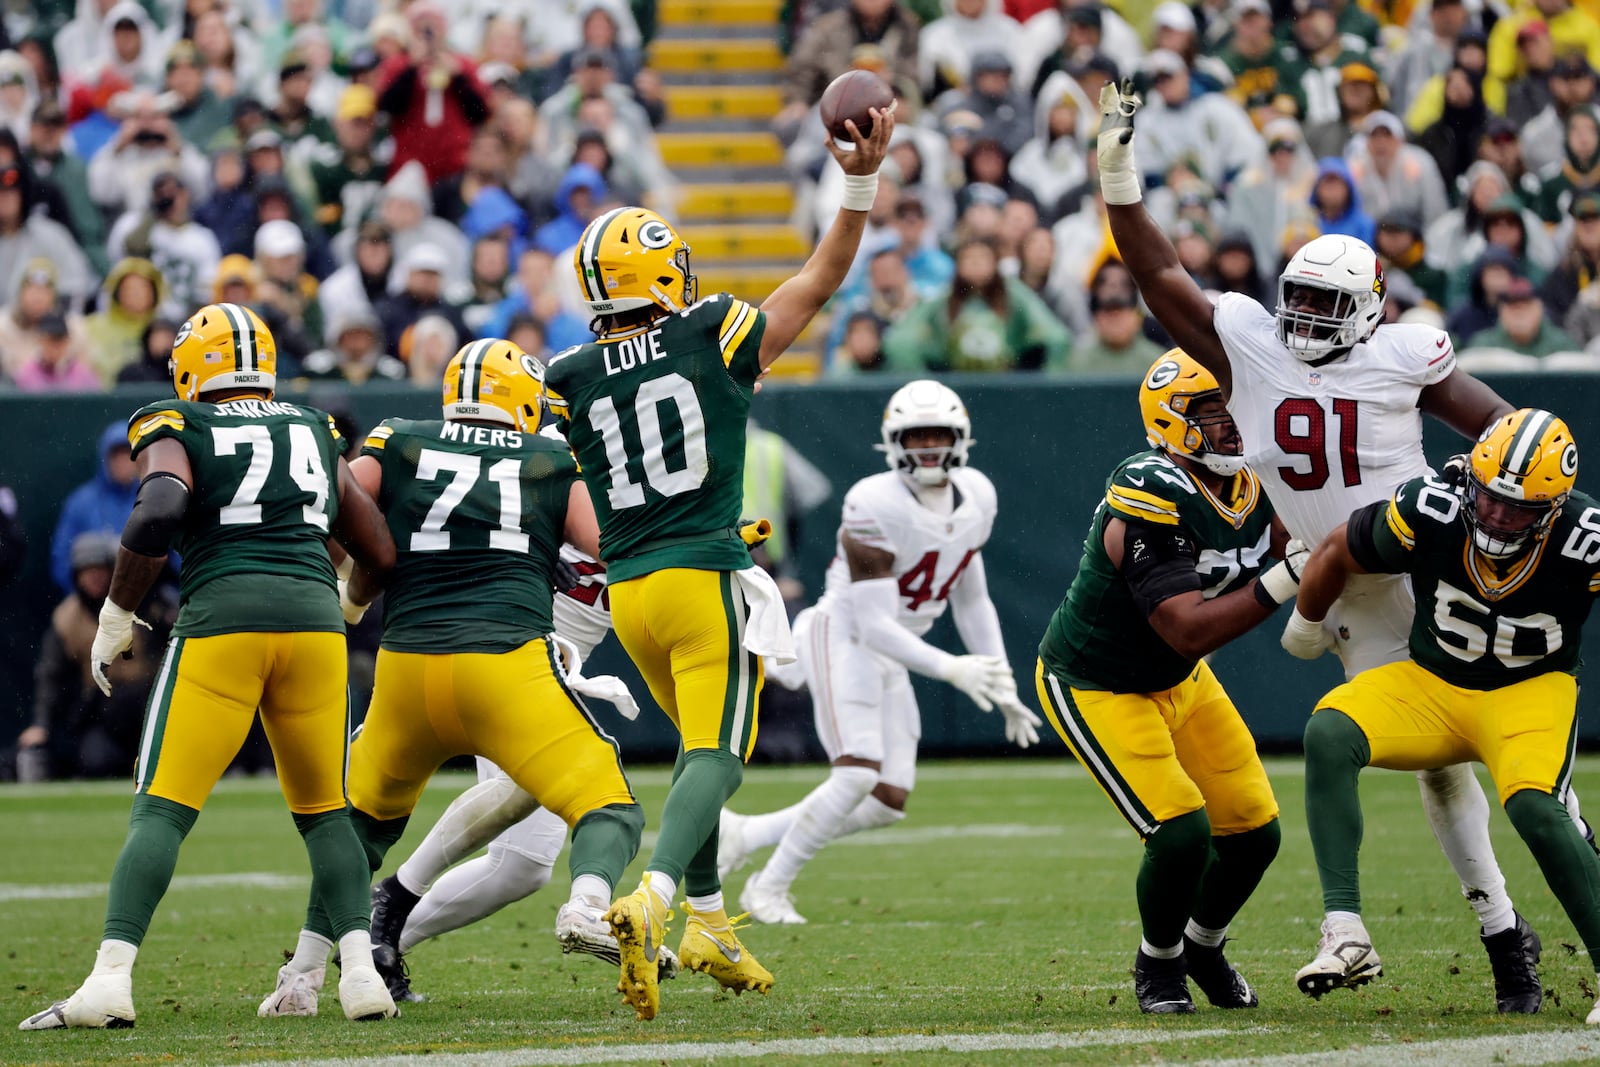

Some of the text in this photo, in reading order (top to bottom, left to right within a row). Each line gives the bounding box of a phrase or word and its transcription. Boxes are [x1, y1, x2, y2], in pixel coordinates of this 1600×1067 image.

[638, 221, 673, 249] G
[592, 303, 614, 311] PACKERS
[602, 328, 667, 377] LOVE
[234, 374, 260, 383] PACKERS
[213, 400, 303, 418] JENKINS
[455, 406, 480, 415] PACKERS
[439, 421, 523, 449] MYERS
[587, 372, 709, 511] 10
[1275, 398, 1362, 491] 91
[211, 423, 330, 533] 74
[410, 448, 530, 554] 71
[1433, 579, 1563, 669] 50
